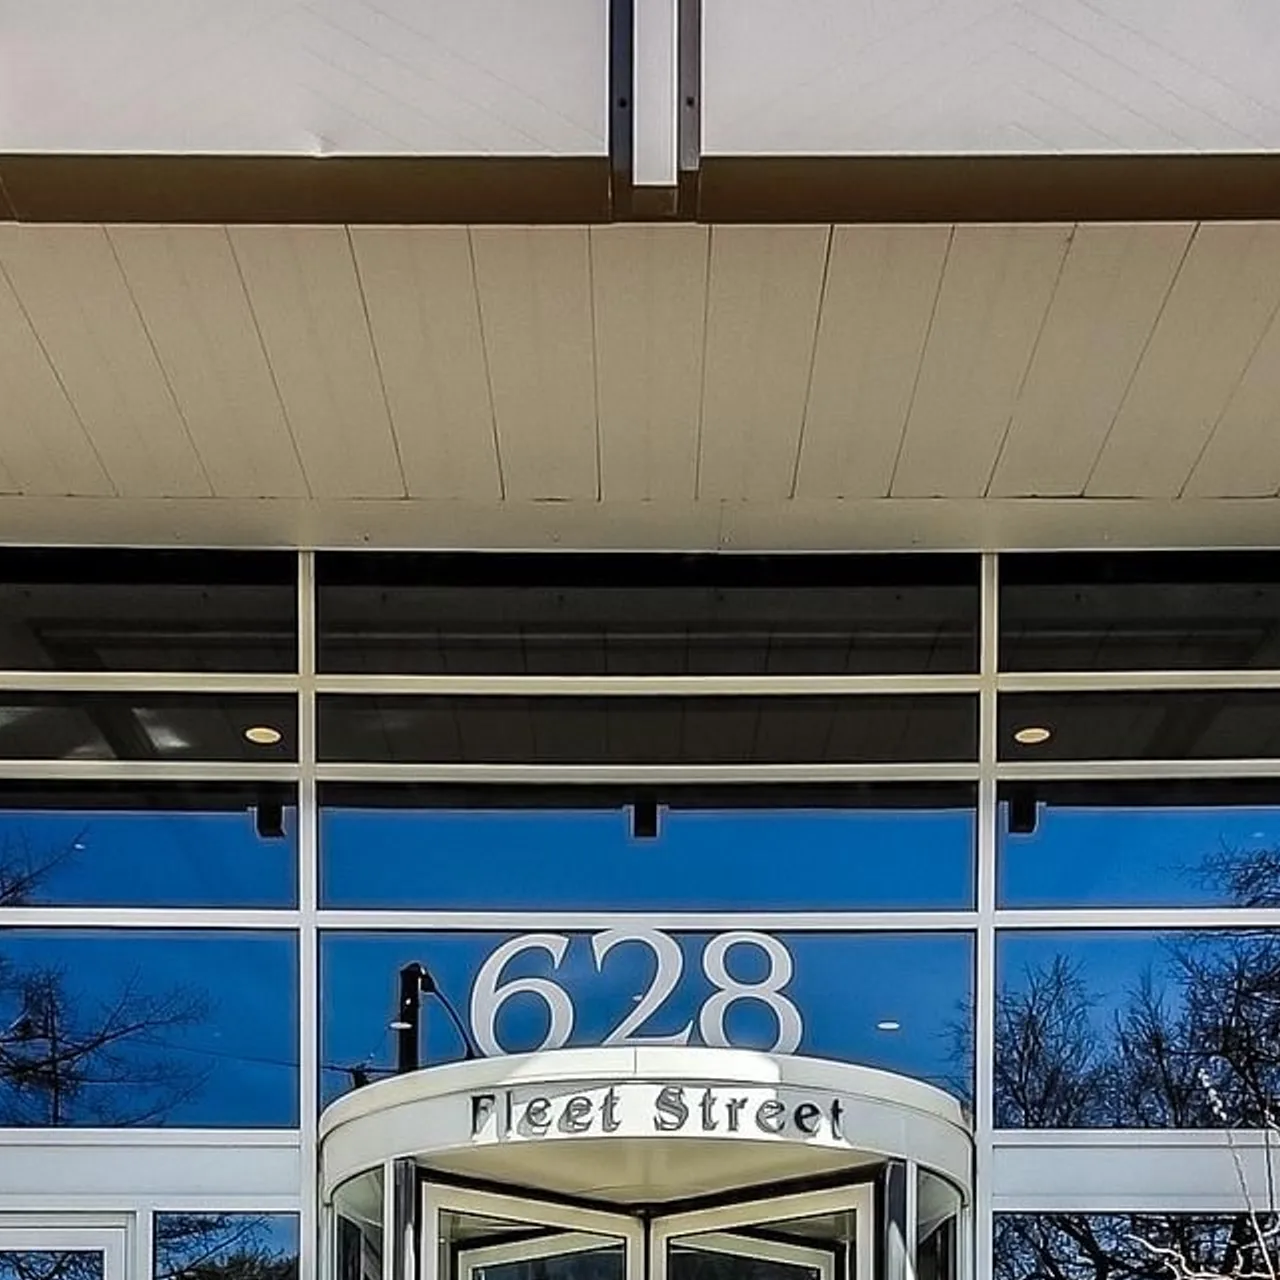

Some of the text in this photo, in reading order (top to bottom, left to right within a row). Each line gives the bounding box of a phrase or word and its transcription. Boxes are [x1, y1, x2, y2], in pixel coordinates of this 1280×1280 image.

[470, 928, 803, 1056] 628
[470, 1085, 844, 1141] Fleet Street
